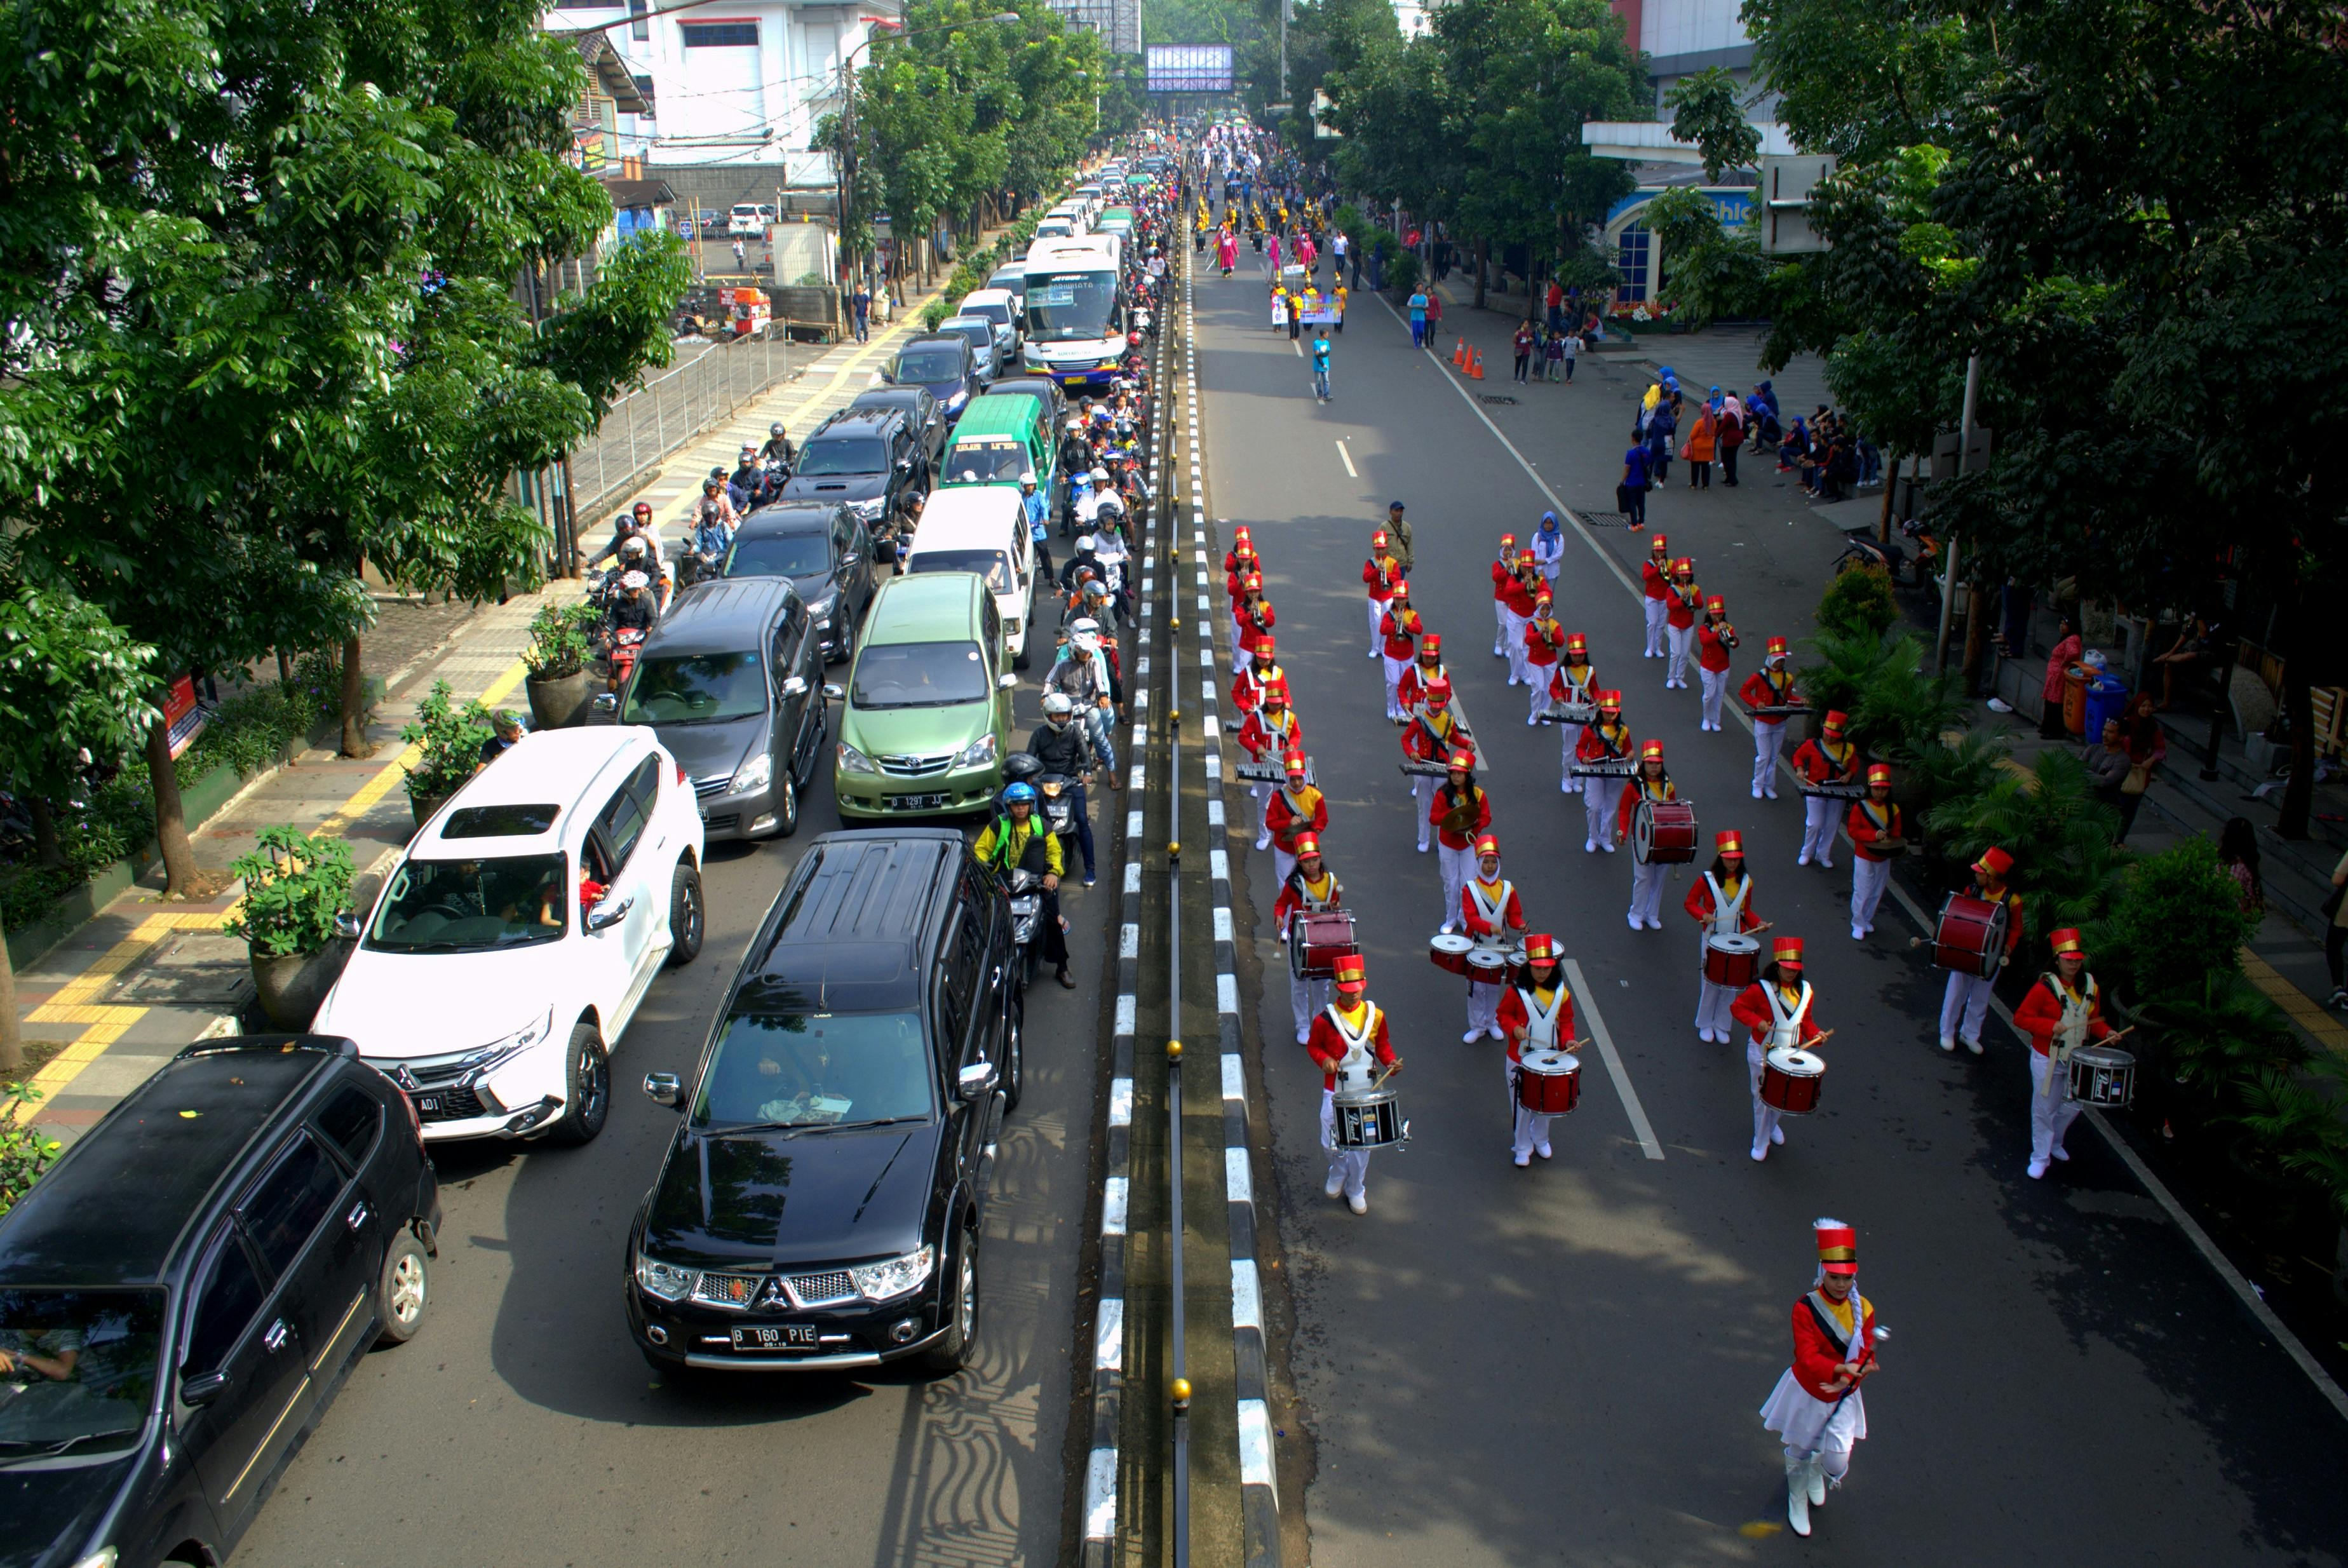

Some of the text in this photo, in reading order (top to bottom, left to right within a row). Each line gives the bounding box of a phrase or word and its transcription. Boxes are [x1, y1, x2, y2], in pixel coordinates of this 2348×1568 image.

[893, 795, 940, 806] D 1297 JJ
[2095, 1068, 2109, 1099] Pearl
[1347, 1109, 1360, 1142] Pearl
[734, 1328, 814, 1342] B 160 PIE
